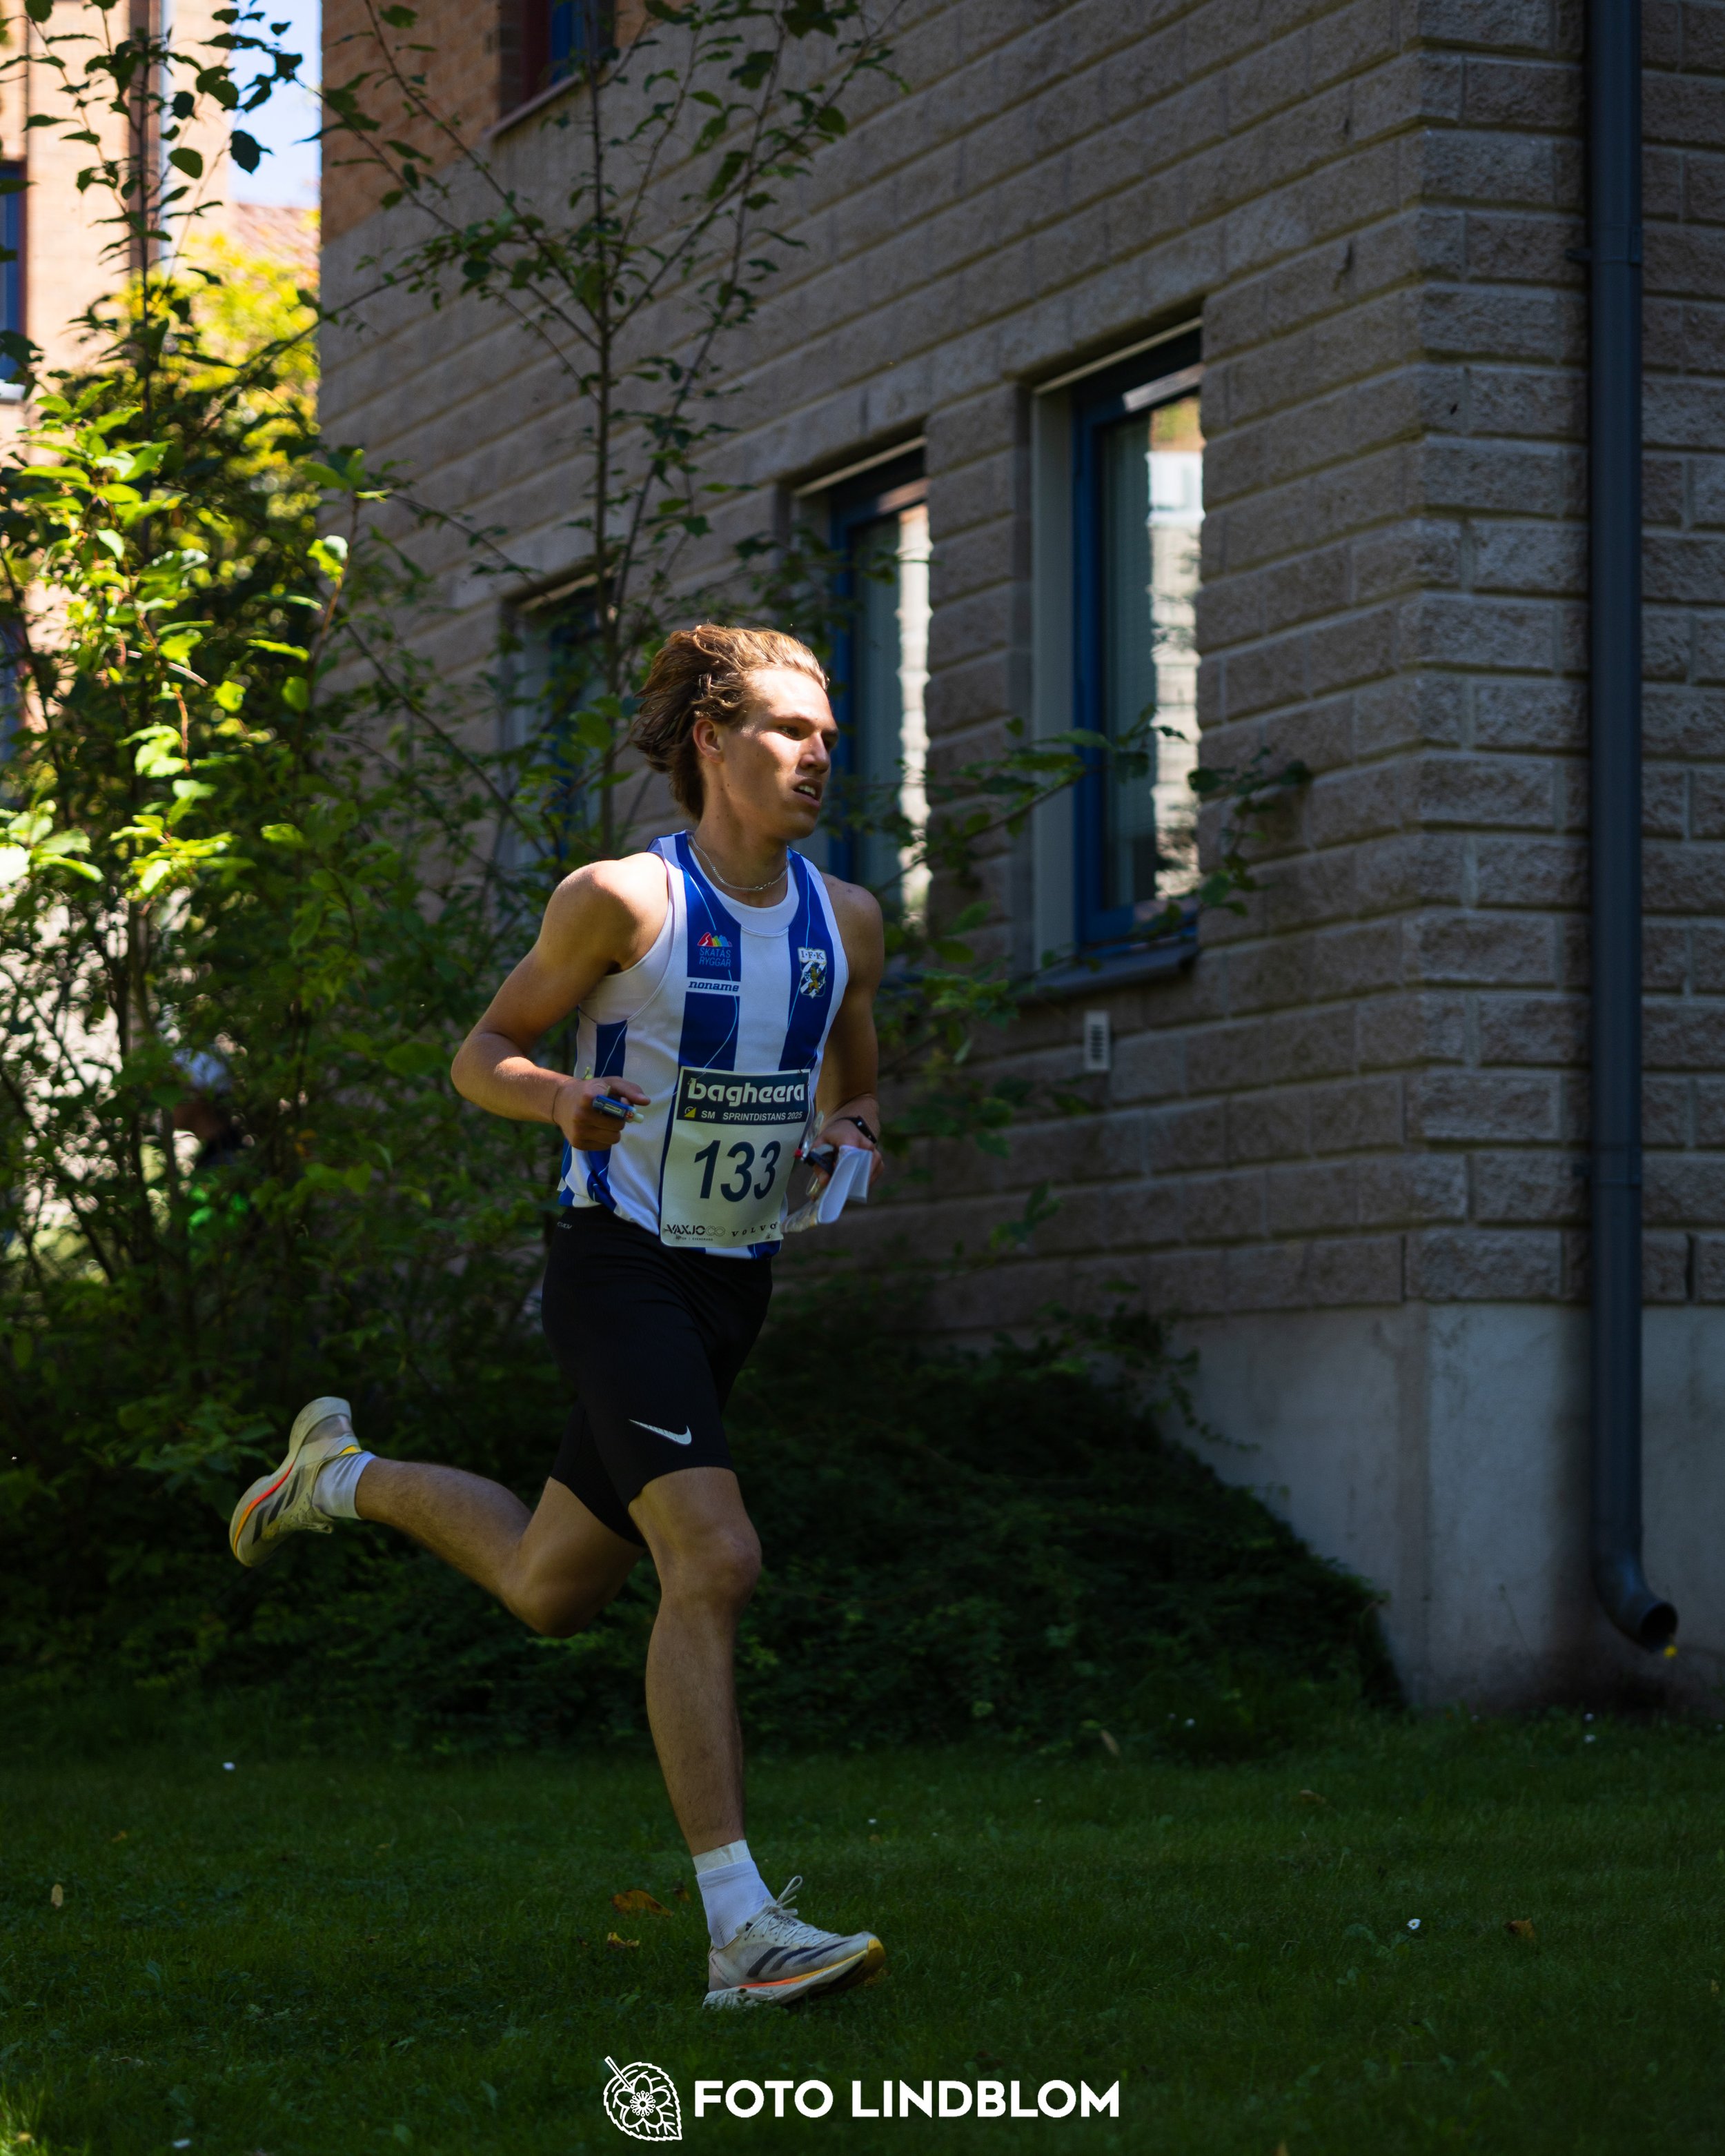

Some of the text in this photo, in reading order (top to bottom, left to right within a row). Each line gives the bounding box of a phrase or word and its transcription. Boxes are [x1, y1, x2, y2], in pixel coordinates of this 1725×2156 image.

[699, 947, 731, 958] SKATÅS
[699, 956, 731, 967] RYGGAR
[688, 980, 740, 992] noname
[687, 1078, 805, 1107] bagheera
[701, 1109, 803, 1121] SM SPRINTDISTANS 2025
[693, 1139, 782, 1203] 133
[731, 1223, 777, 1237] VOLVO
